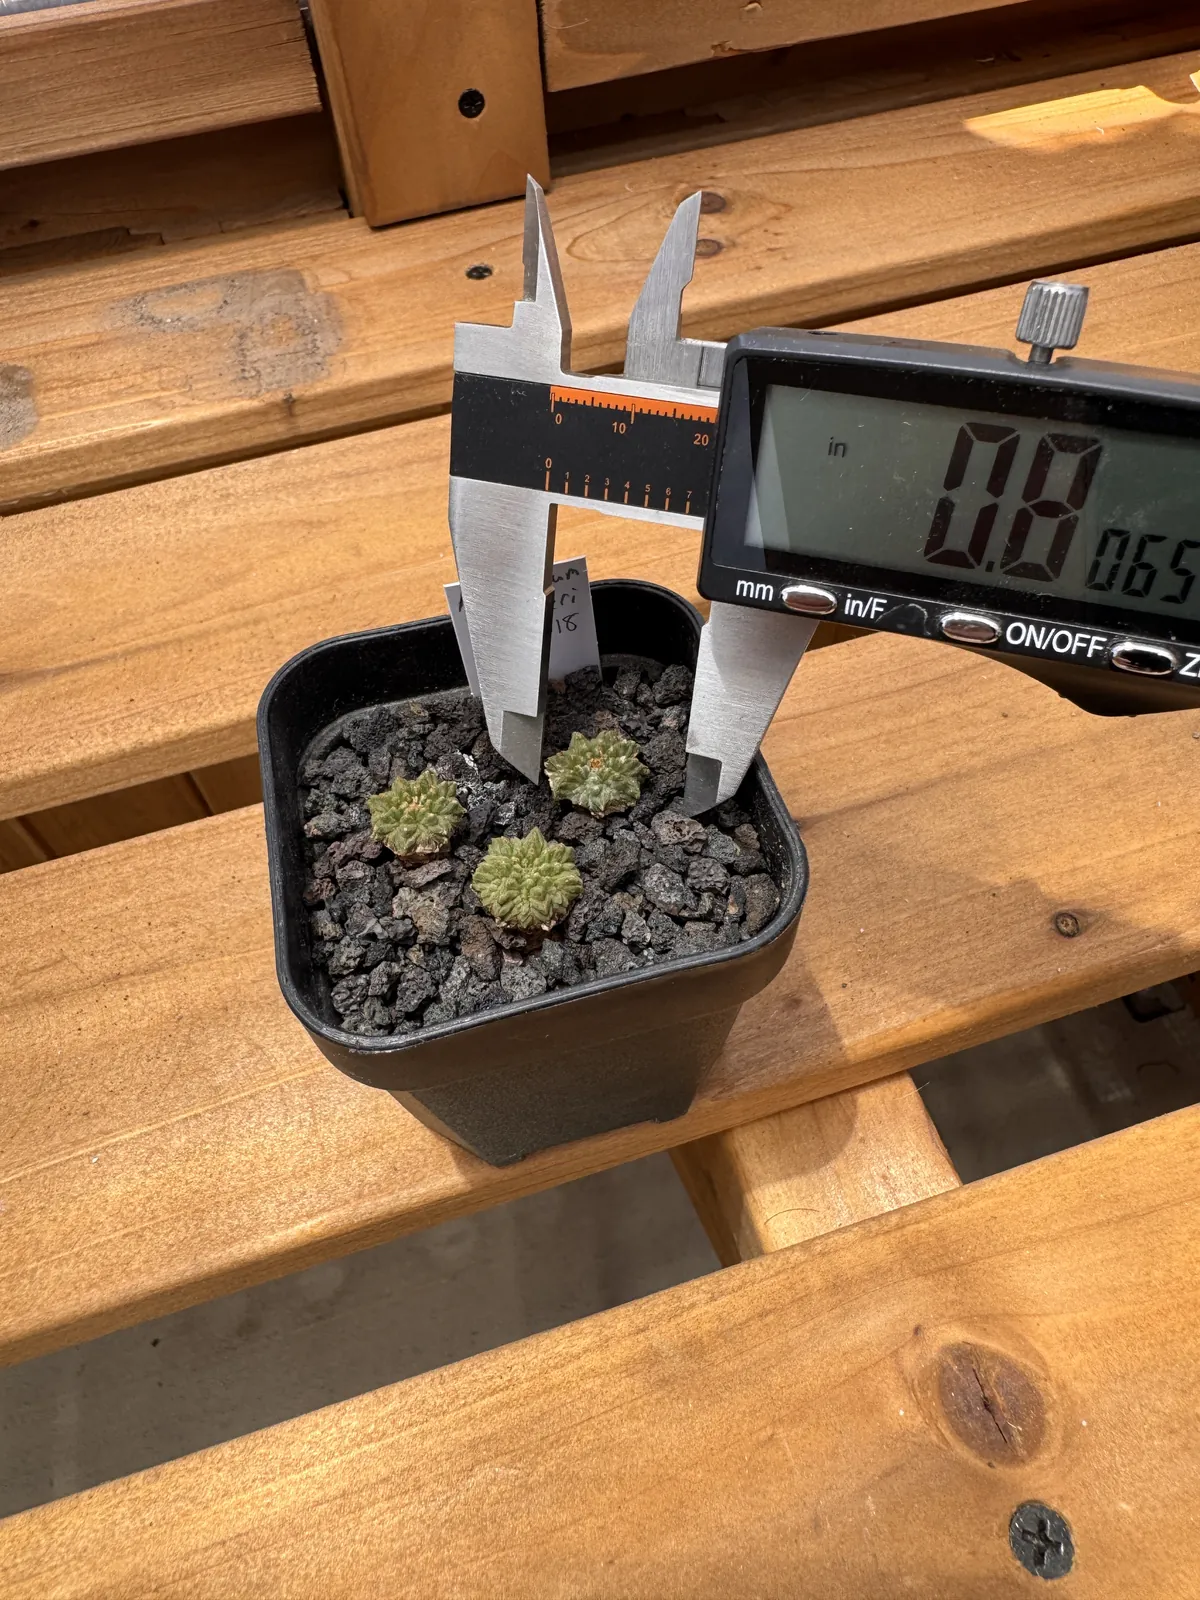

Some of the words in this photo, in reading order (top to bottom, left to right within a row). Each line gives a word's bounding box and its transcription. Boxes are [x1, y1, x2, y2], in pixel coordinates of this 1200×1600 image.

[554, 413, 563, 425] 0
[611, 421, 627, 435] 10
[693, 433, 710, 447] 20
[828, 436, 847, 458] in
[544, 457, 553, 469] 0
[564, 471, 571, 480] 1
[583, 474, 591, 483] 2
[604, 477, 611, 486] 3
[623, 481, 631, 489] 4
[644, 484, 652, 493] 5
[665, 487, 673, 496] 6
[685, 490, 693, 499] 7
[735, 579, 774, 602] mm
[844, 593, 888, 620] in/F
[1005, 621, 1108, 658] ON/OFF
[1178, 652, 1200, 678] Z
